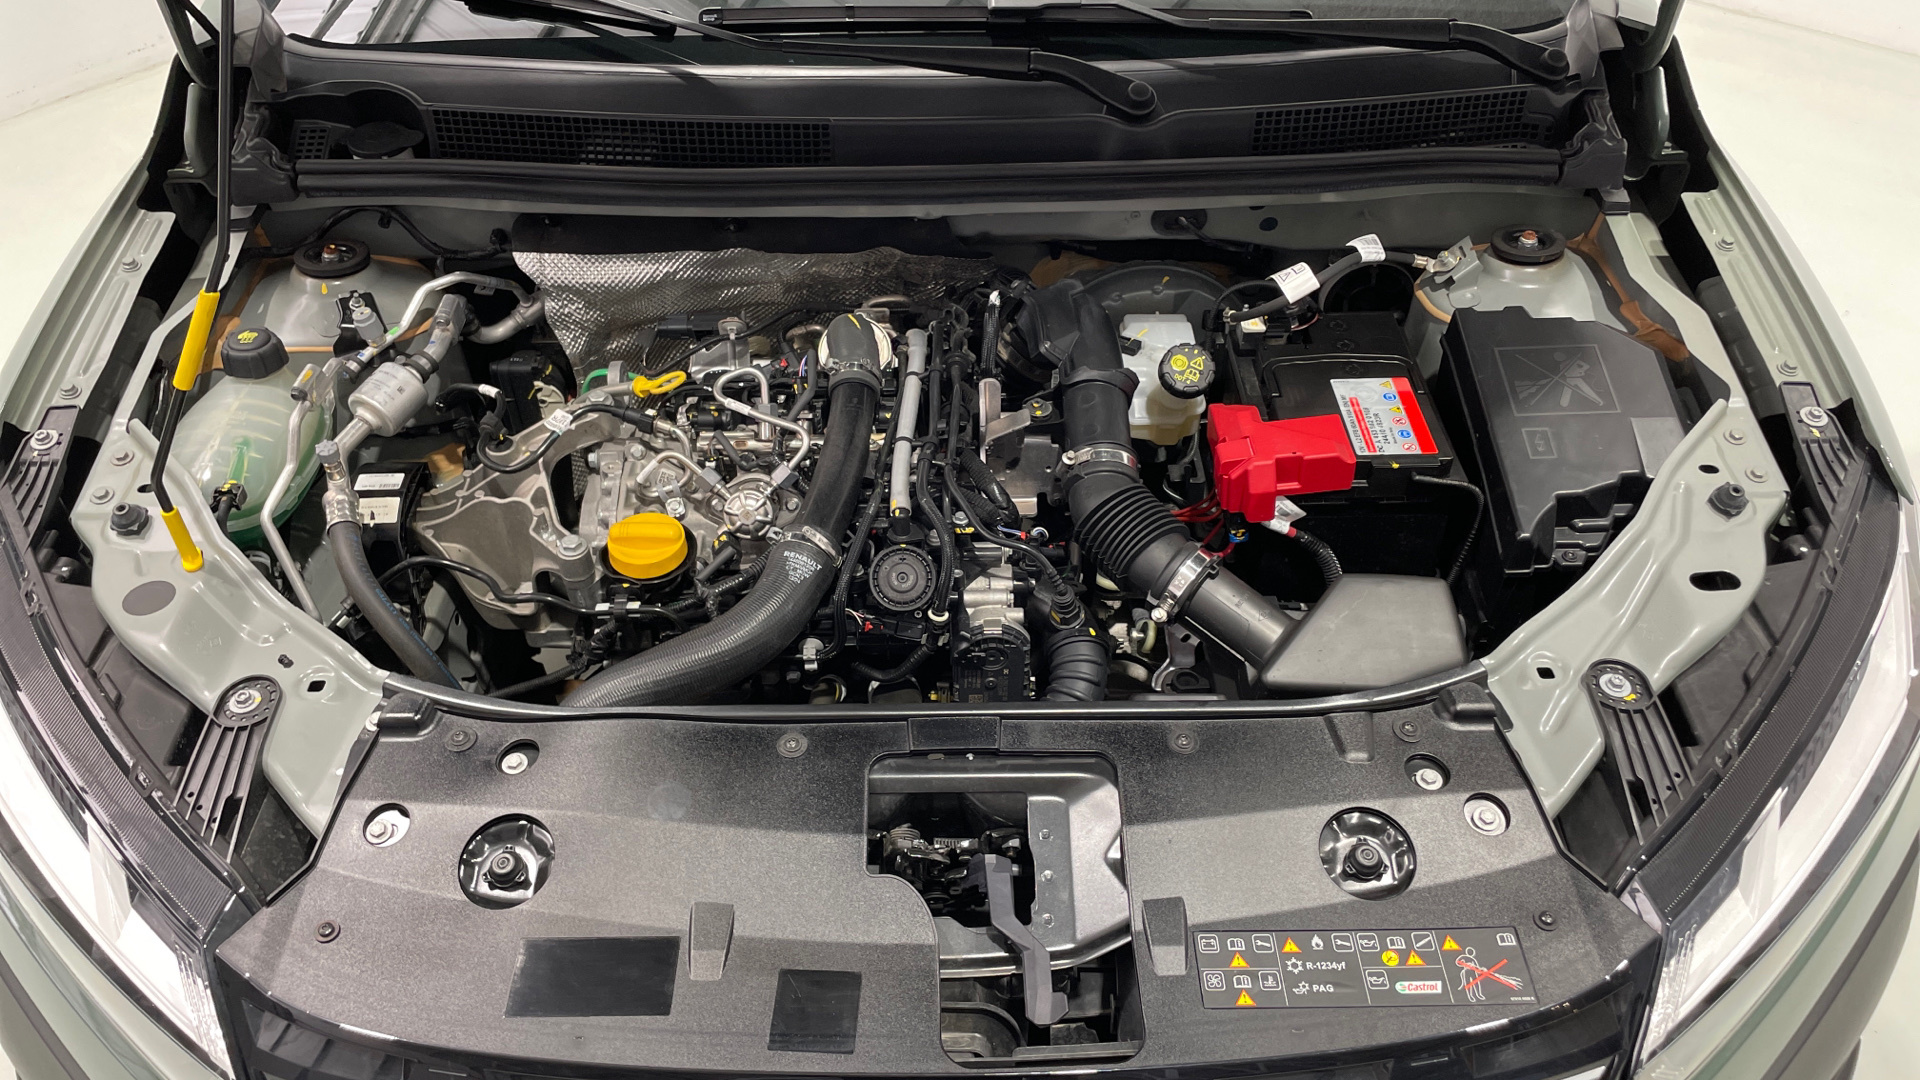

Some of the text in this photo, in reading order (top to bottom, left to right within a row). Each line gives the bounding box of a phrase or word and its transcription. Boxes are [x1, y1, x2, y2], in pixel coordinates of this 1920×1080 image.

[1174, 373, 1187, 382] DOT
[783, 551, 822, 570] RENAULT
[1306, 961, 1346, 971] R-1234yf
[1312, 984, 1335, 993] PAG
[1407, 983, 1438, 992] Castrol
